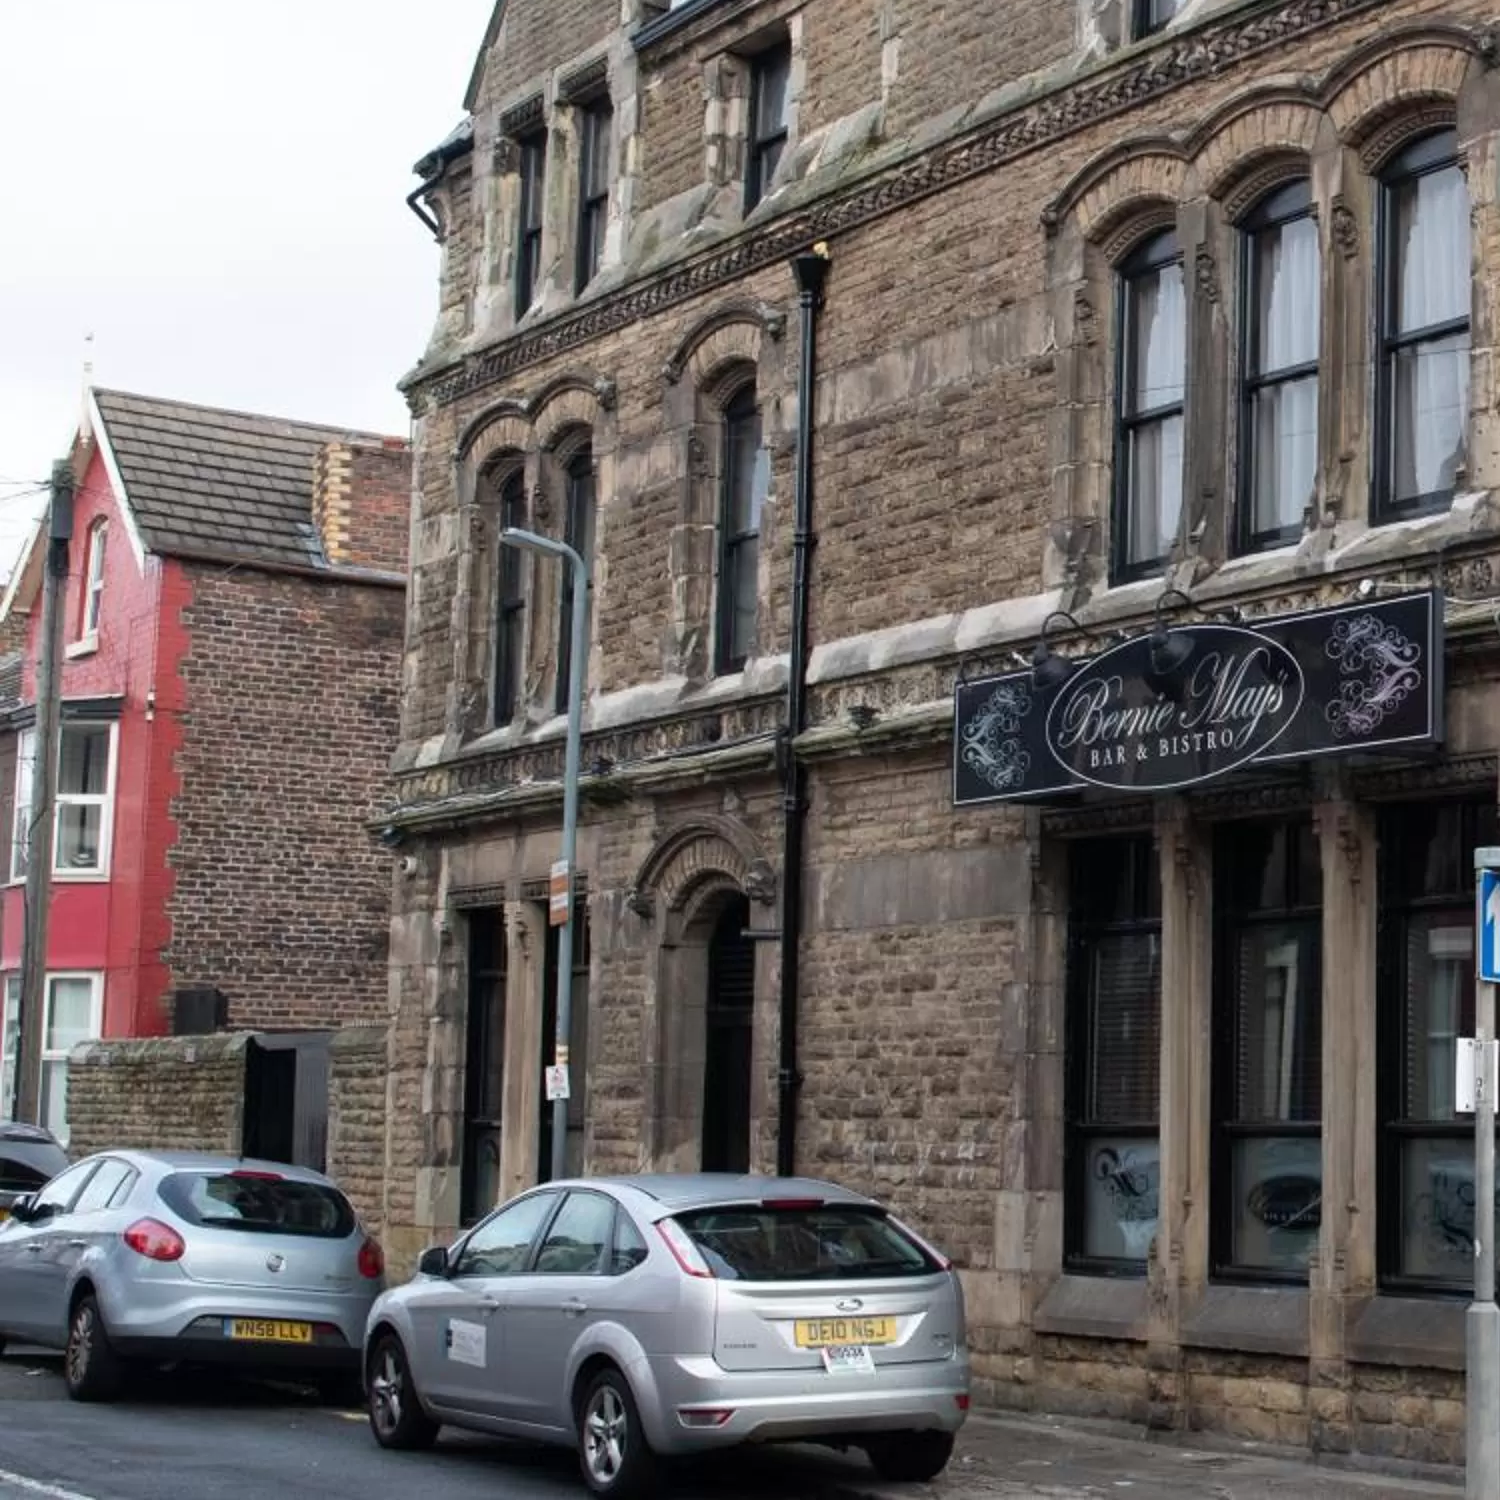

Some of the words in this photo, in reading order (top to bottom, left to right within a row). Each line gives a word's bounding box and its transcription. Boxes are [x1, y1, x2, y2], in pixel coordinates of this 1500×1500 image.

[1057, 676, 1175, 748] Bernie
[1090, 744, 1127, 767] BAR
[1136, 743, 1149, 761] &
[1158, 728, 1233, 757] BISTRO
